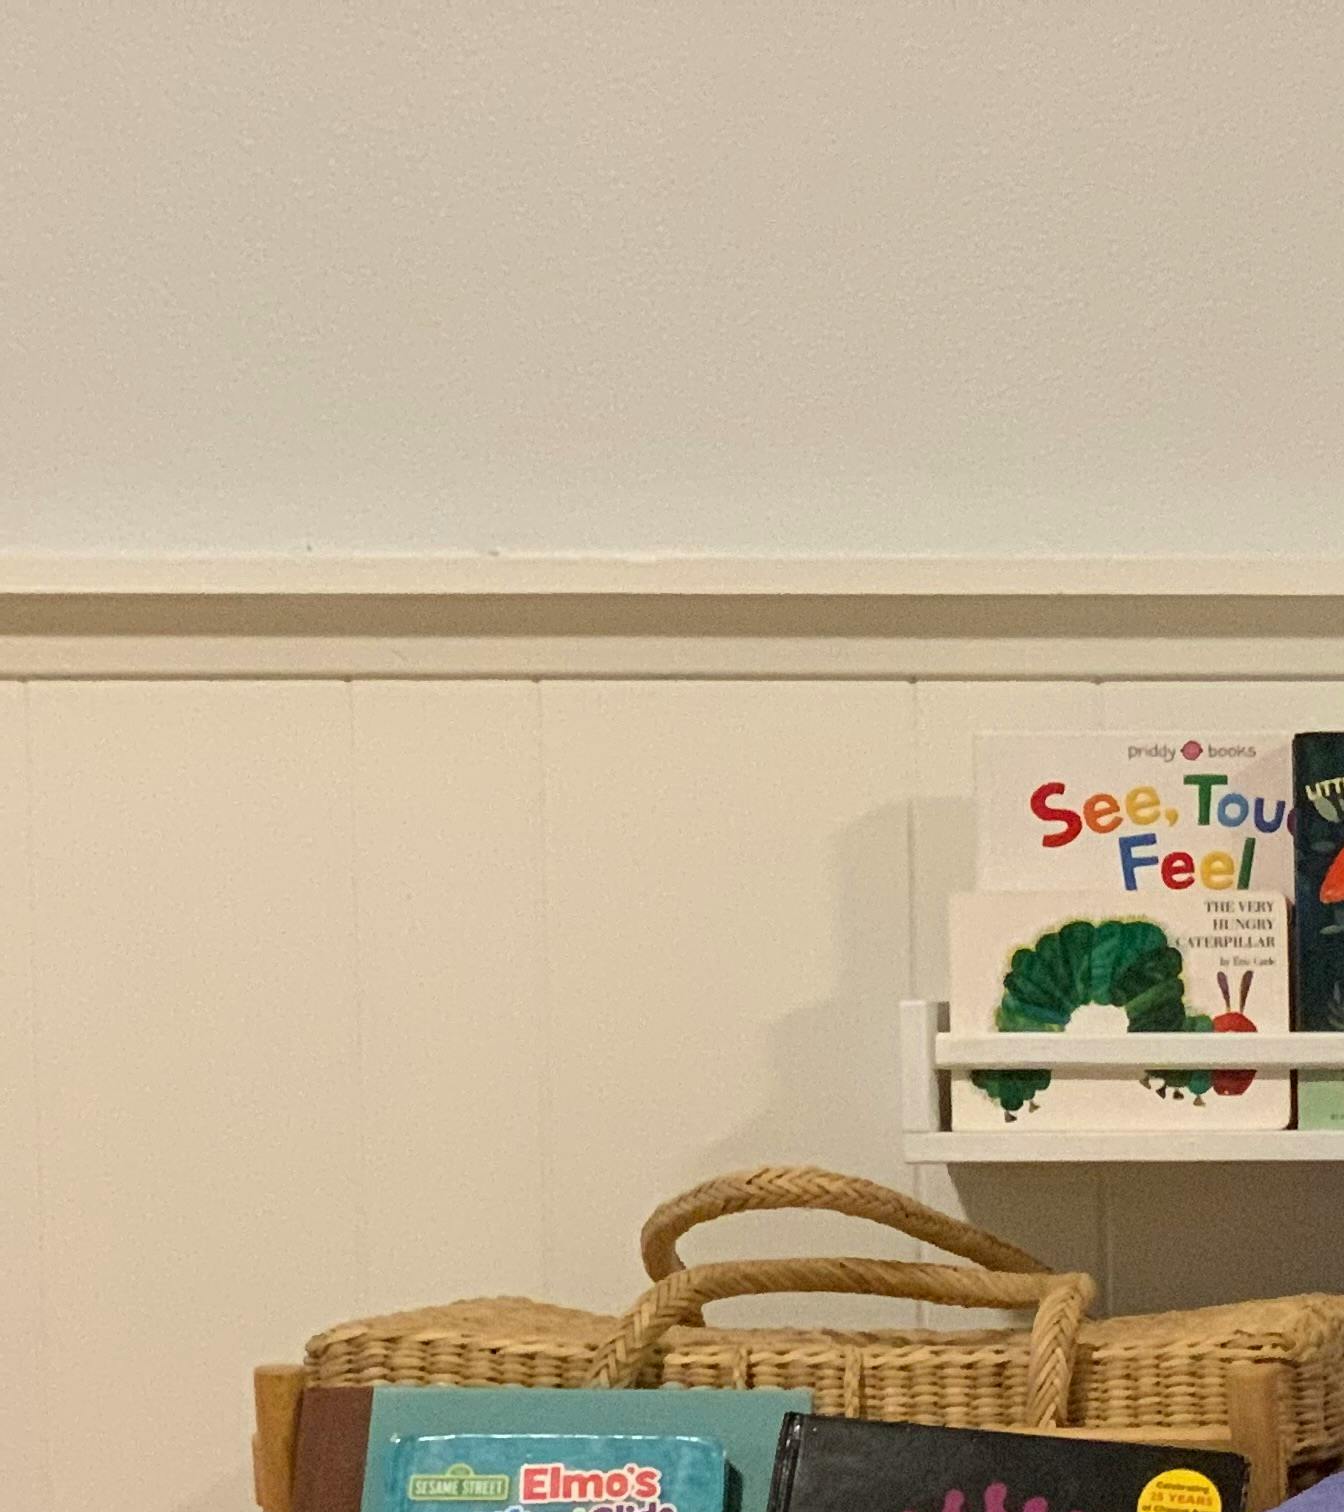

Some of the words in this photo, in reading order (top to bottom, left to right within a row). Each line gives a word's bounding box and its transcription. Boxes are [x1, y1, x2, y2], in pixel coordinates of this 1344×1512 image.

[1128, 744, 1176, 762] priddy
[1208, 744, 1256, 758] books
[1030, 782, 1179, 848] See,
[1118, 833, 1256, 891] Feel
[1204, 901, 1234, 912] THE
[1239, 901, 1273, 912] VERY
[1213, 919, 1273, 930] HUNGRY
[1175, 936, 1275, 948] CATERPILLAR
[415, 1479, 459, 1496] SESAME
[460, 1478, 504, 1496] STREET
[523, 1465, 659, 1501] Elmo's
[1169, 1493, 1213, 1506] YEARS
